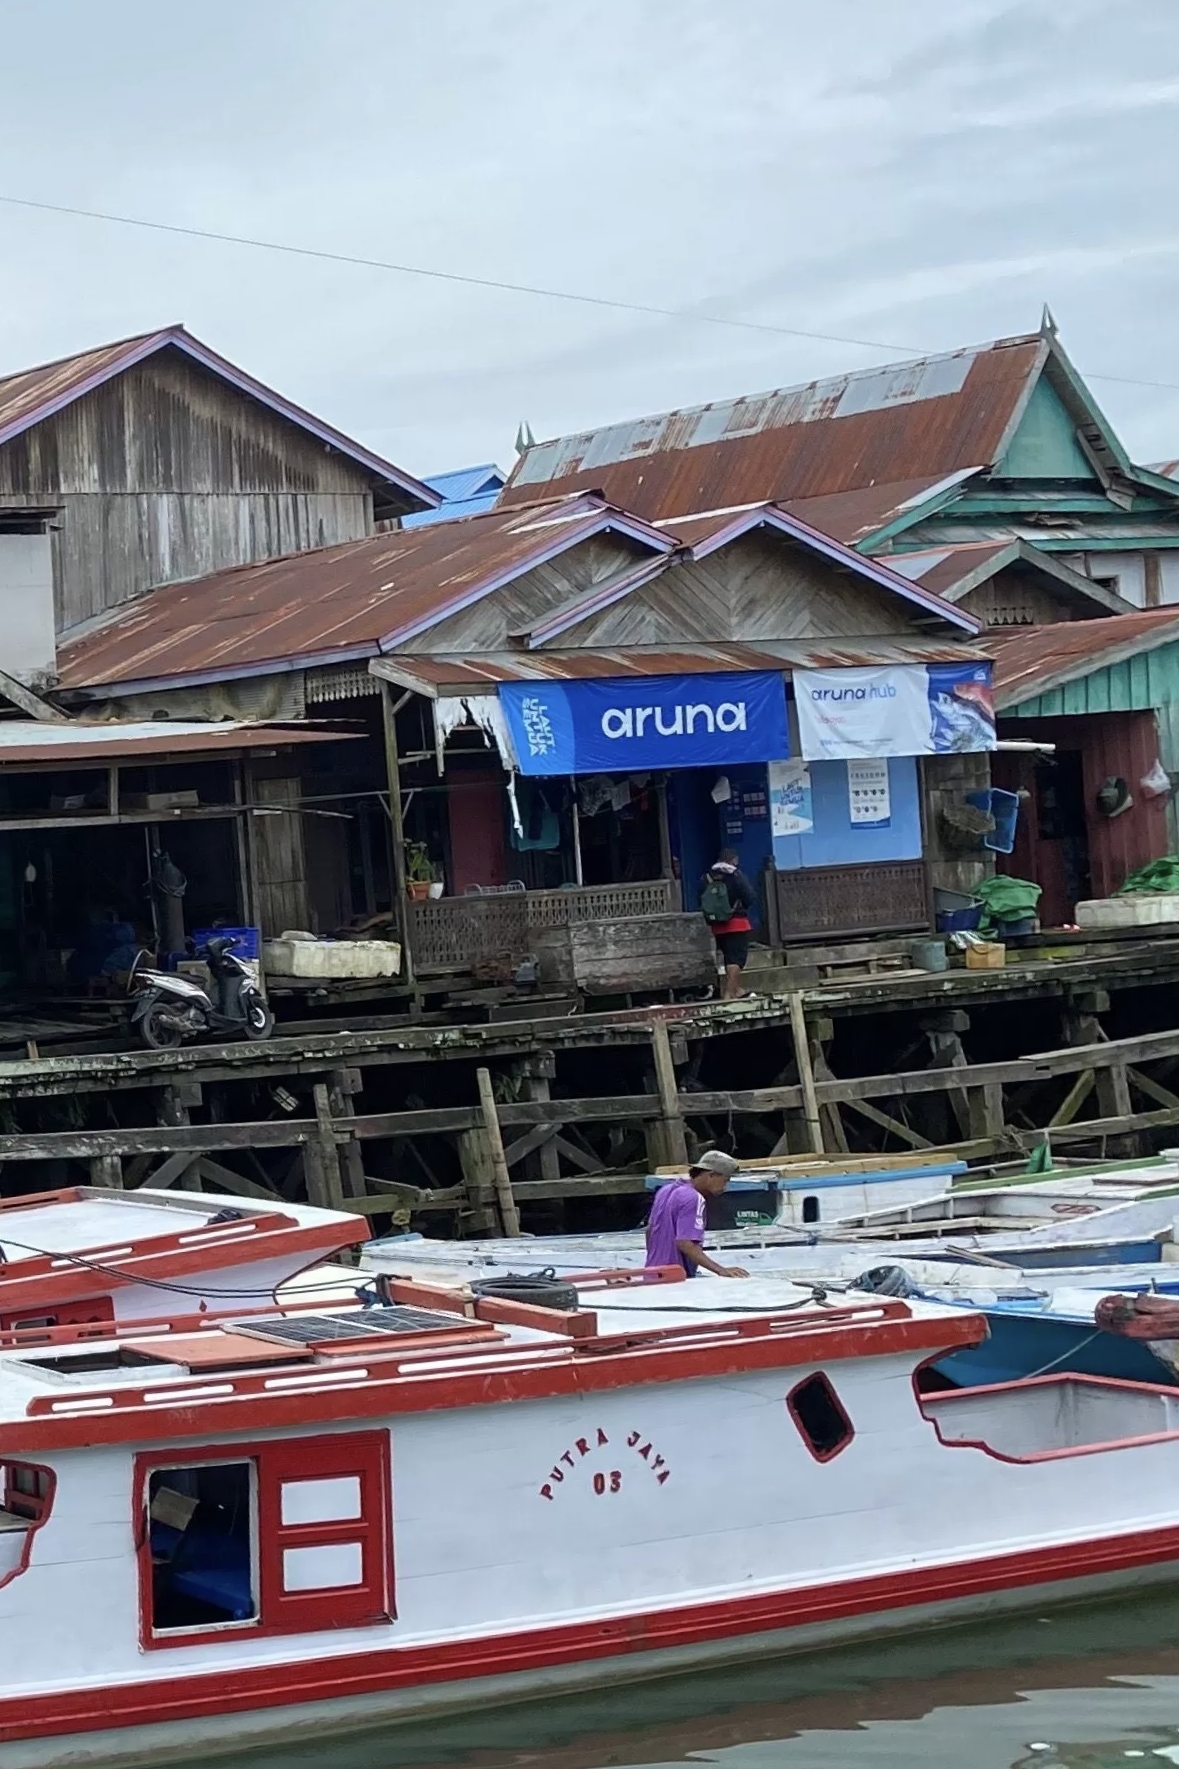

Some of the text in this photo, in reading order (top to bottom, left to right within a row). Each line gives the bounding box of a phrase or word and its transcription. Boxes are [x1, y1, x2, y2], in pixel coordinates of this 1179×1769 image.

[812, 682, 897, 701] aruna hub
[522, 697, 539, 758] SEMUA
[530, 698, 548, 755] UNTUK
[539, 705, 556, 747] LAUT
[601, 702, 747, 739] aruna
[539, 1427, 670, 1501] PUTRA JAYA
[593, 1470, 622, 1496] 03
